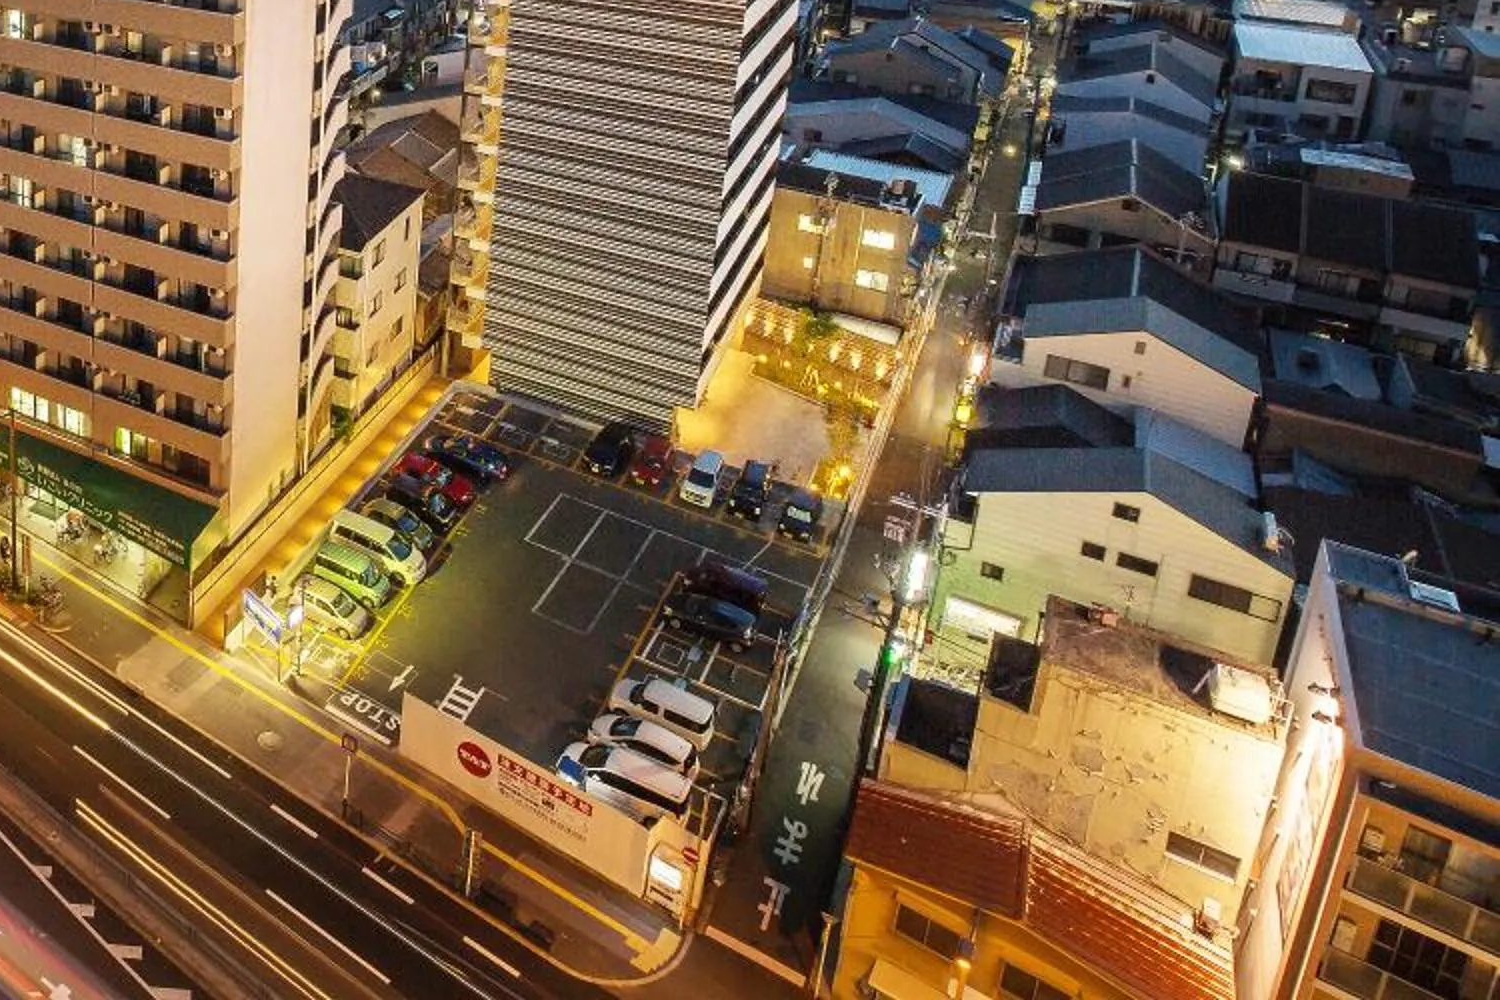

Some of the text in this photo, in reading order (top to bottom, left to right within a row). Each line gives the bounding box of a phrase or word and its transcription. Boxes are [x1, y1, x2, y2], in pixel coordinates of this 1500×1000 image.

[340, 692, 401, 731] STOP
[757, 761, 827, 933] 止まれ
